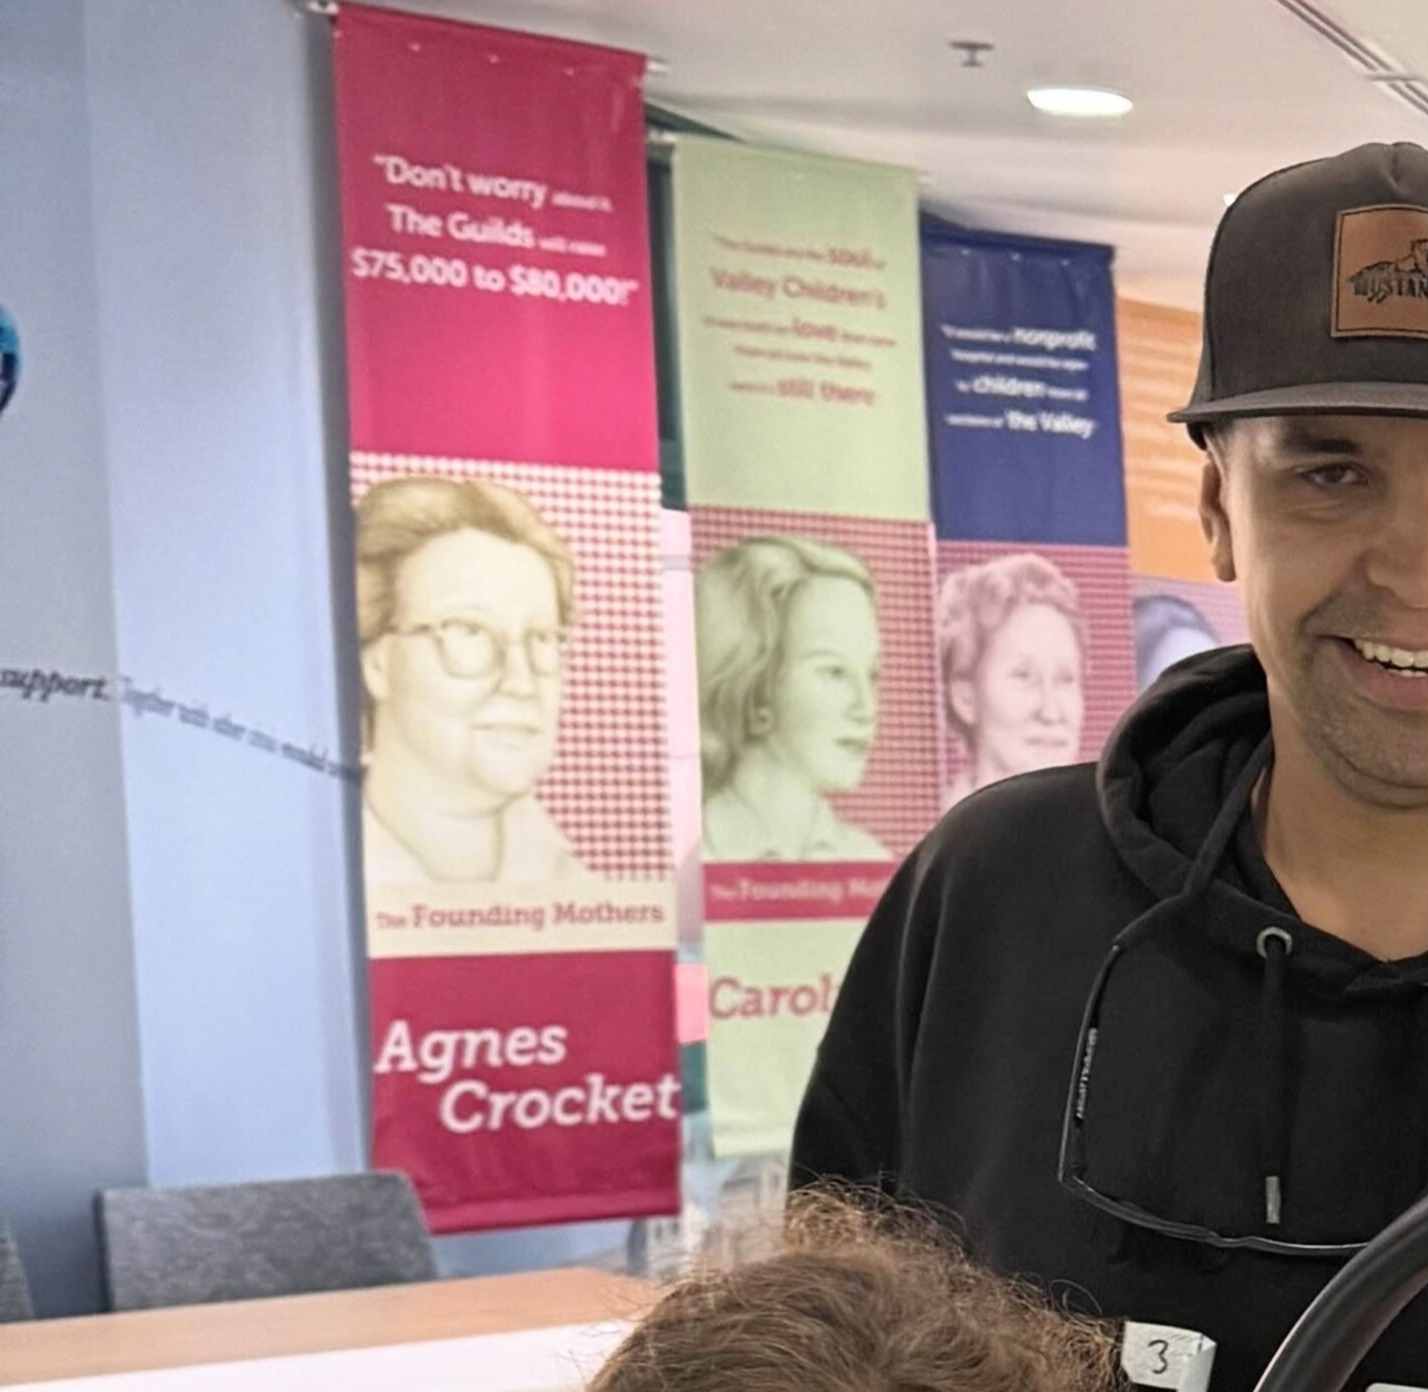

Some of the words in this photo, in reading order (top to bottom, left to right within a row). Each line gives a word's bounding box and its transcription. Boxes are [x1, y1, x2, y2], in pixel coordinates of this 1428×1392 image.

[466, 173, 547, 209] worry
[385, 203, 442, 237] The
[447, 211, 535, 249] Guilds
[351, 246, 468, 288] $75,000
[473, 263, 506, 291] to
[708, 266, 776, 301] Valley
[1038, 411, 1096, 439] Valley
[411, 904, 546, 931] Founding
[552, 901, 665, 926] Mothers
[709, 974, 834, 1019] Carol
[372, 1018, 569, 1085] Agnes
[439, 1071, 682, 1134] Crocket
[1148, 1339, 1169, 1375] 3
